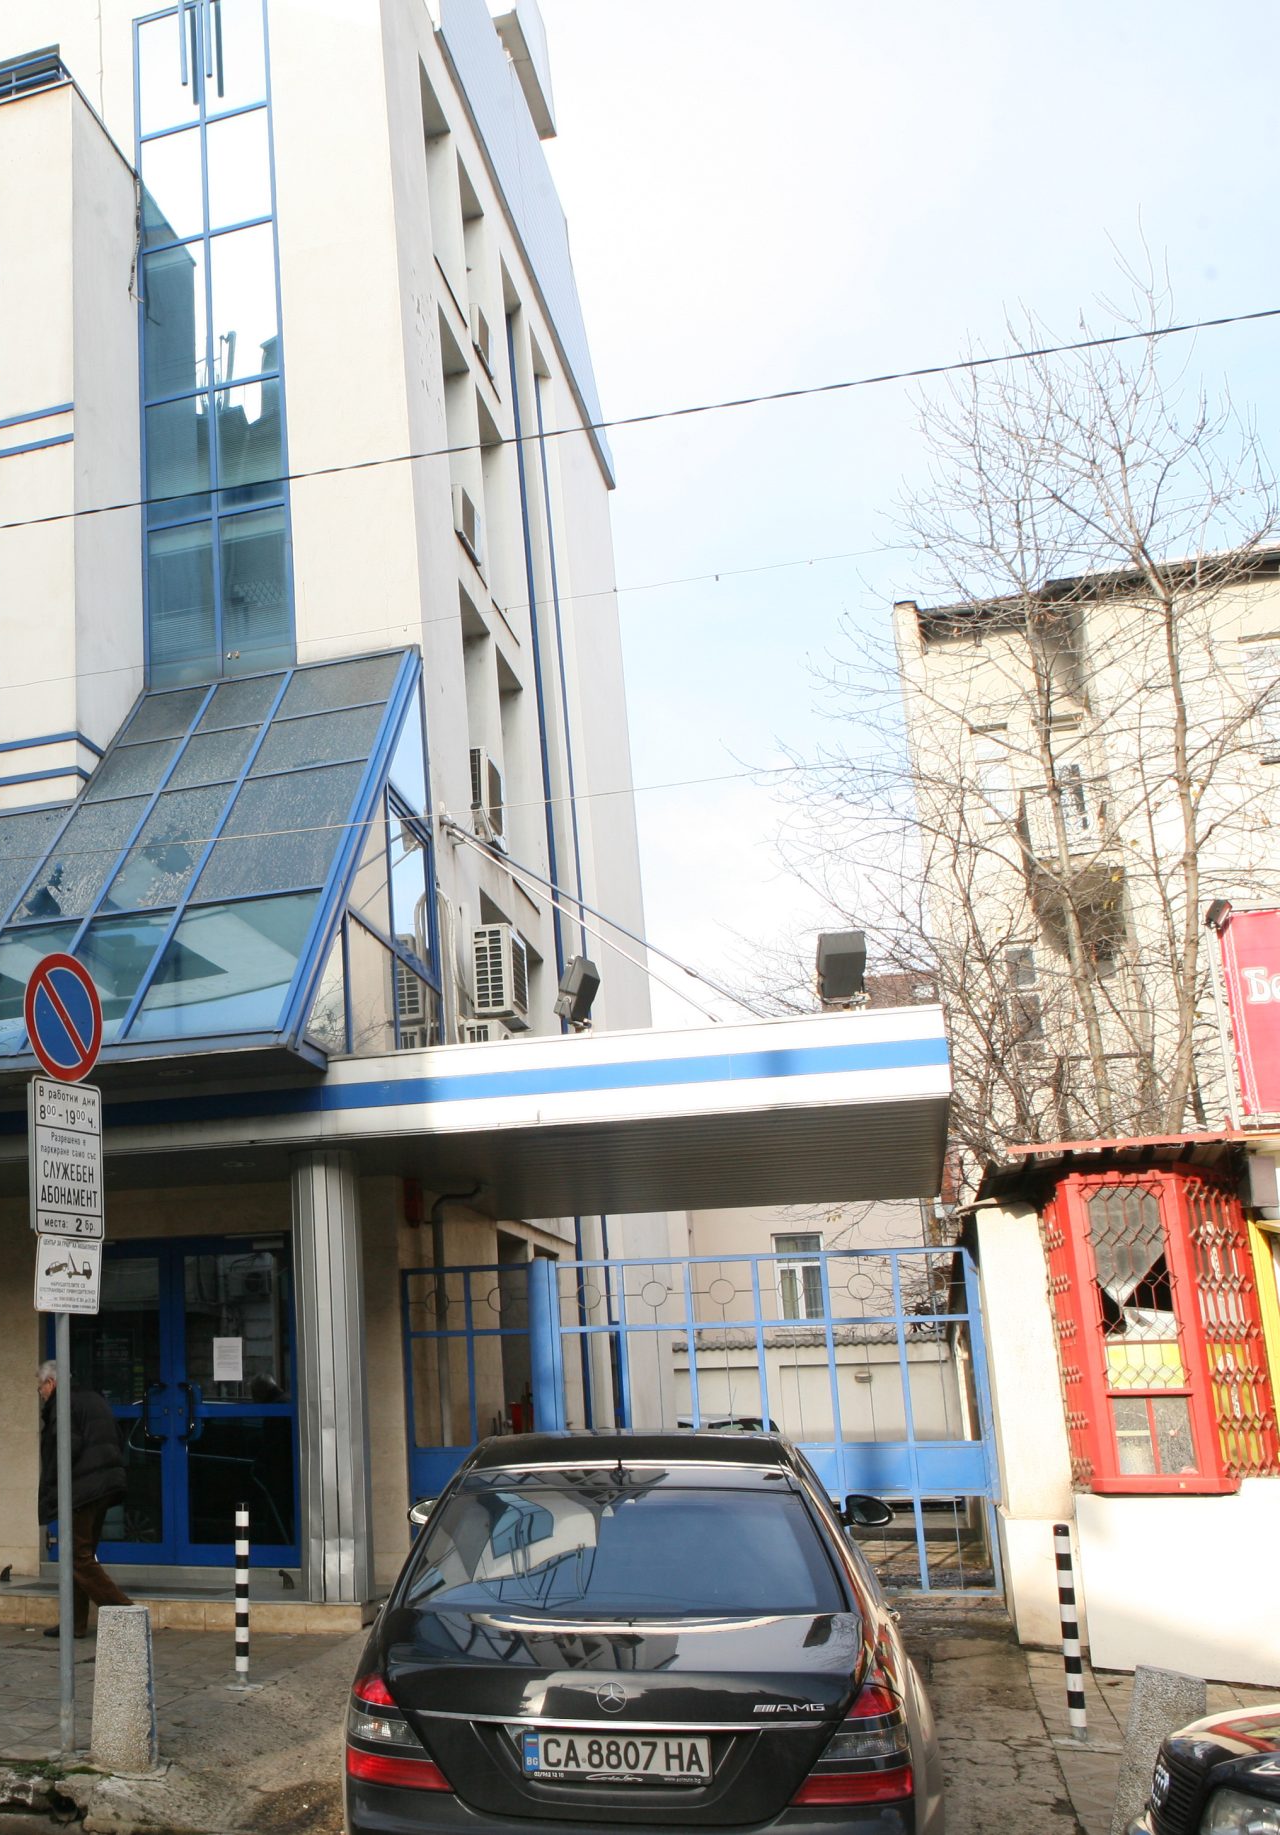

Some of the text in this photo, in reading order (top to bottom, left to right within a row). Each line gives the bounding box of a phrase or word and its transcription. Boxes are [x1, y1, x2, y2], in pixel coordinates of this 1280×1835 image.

[39, 1085, 96, 1107] В работни дни
[41, 1144, 97, 1161] паркиране само със
[43, 1160, 94, 1184] СЛУЖЕБЕН
[41, 1184, 98, 1208] АБОНАМЕНТ
[44, 1217, 96, 1233] места: 2 бр.
[776, 1703, 826, 1713] AMG
[526, 1757, 539, 1766] BG
